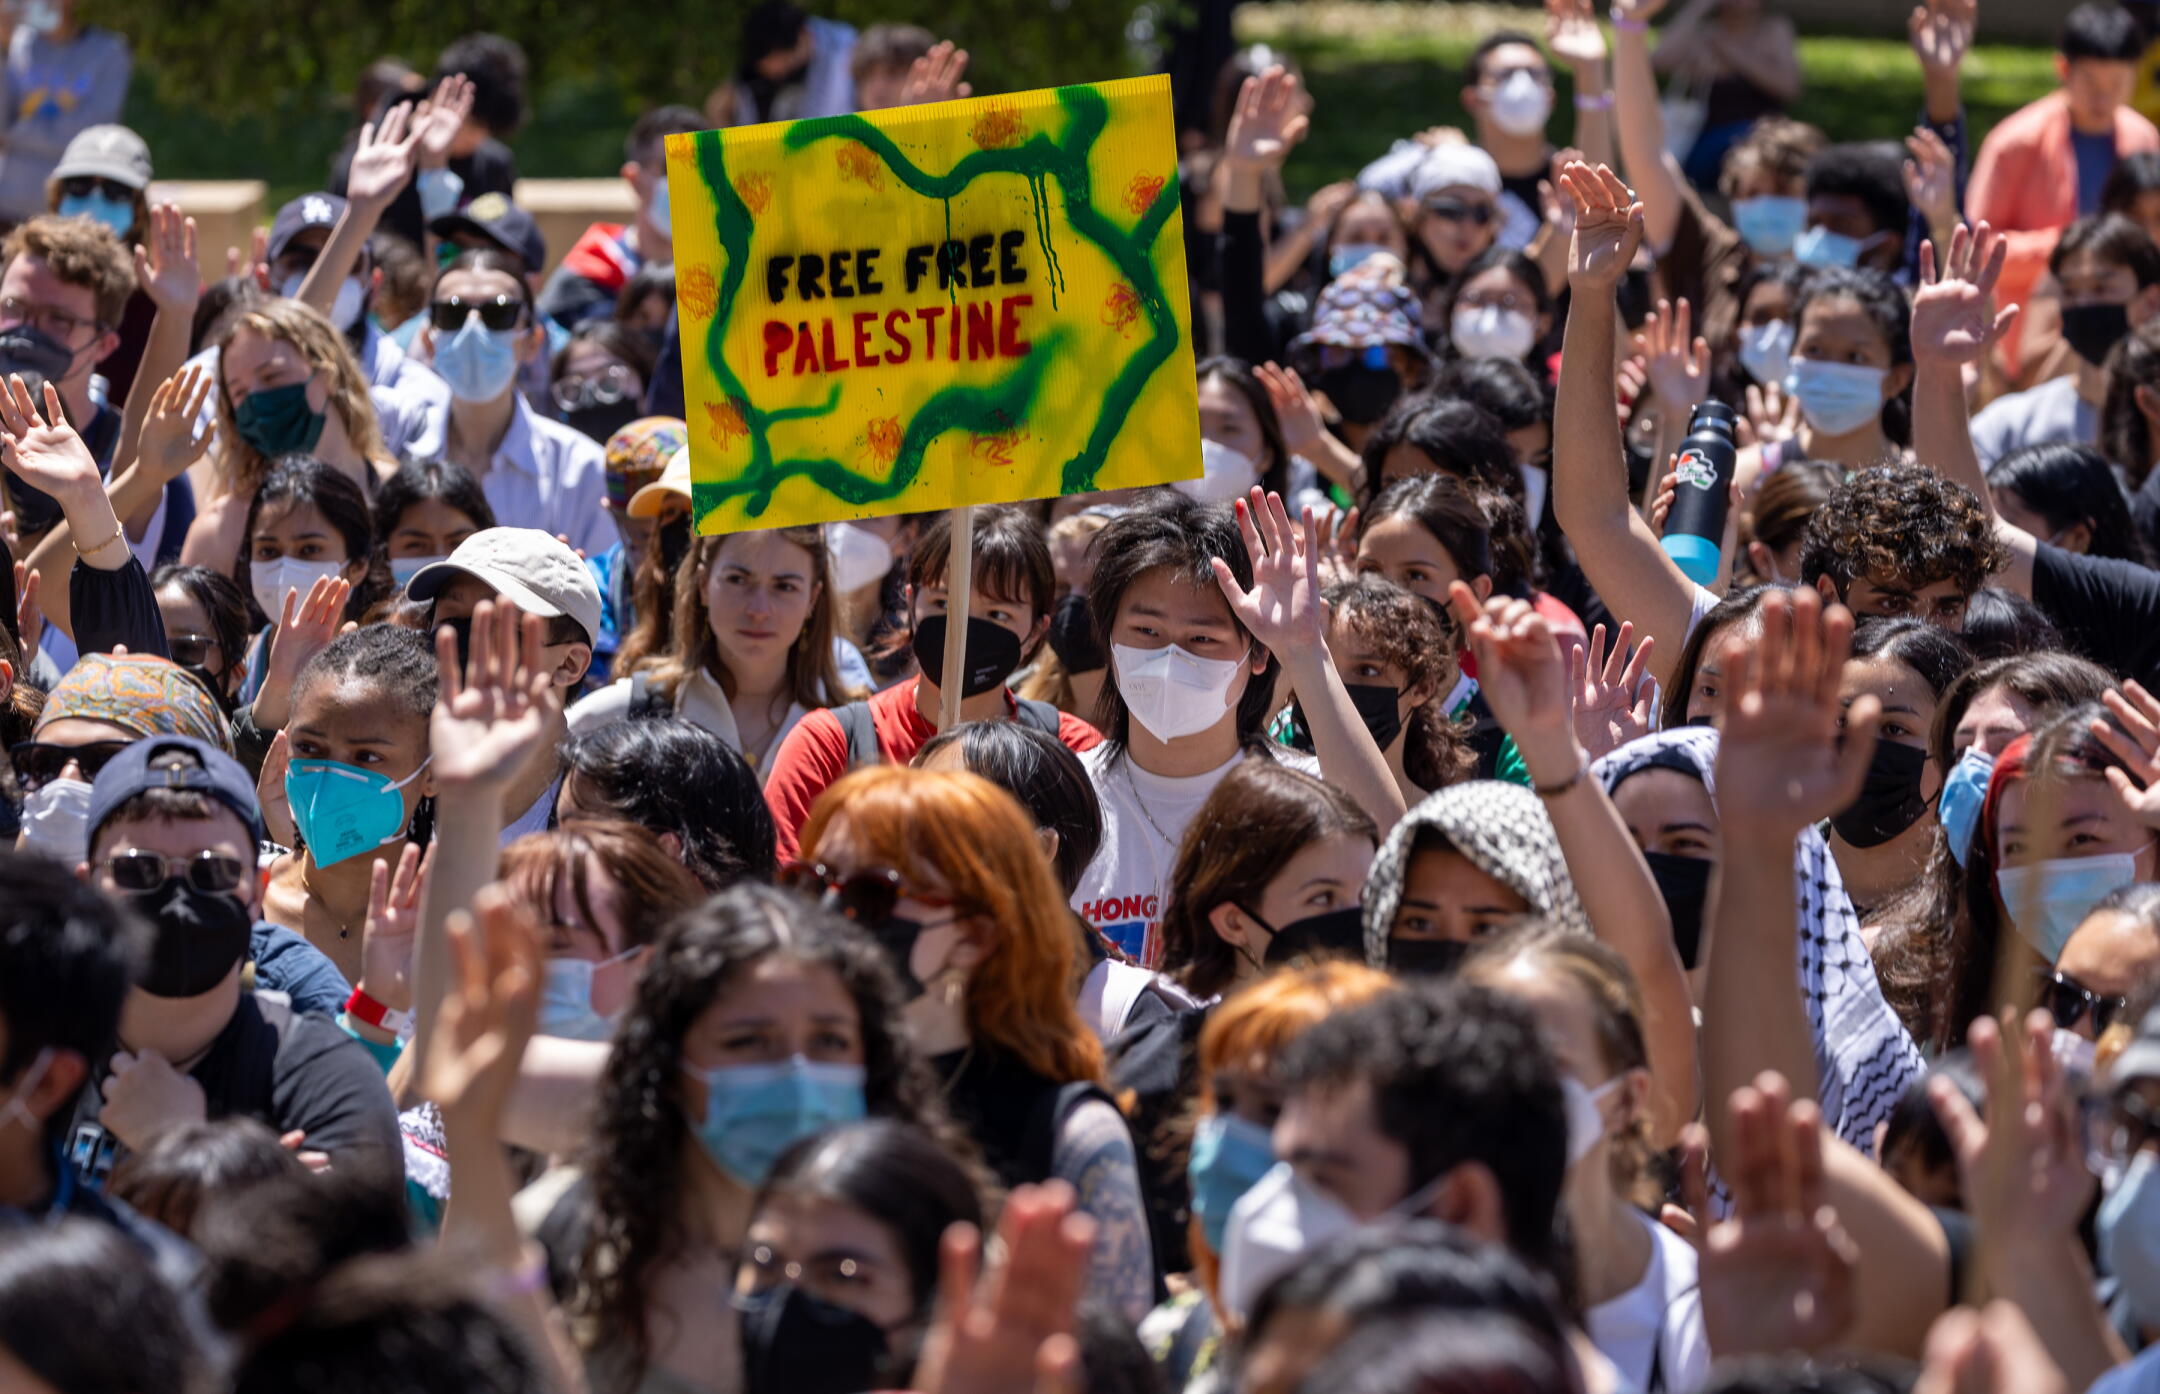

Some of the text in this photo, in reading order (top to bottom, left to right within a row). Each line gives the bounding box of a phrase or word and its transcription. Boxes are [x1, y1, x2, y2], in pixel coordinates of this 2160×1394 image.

[767, 230, 1028, 304] FREE FREE
[763, 294, 1034, 377] PALESTINE
[1082, 894, 1159, 923] HONG
